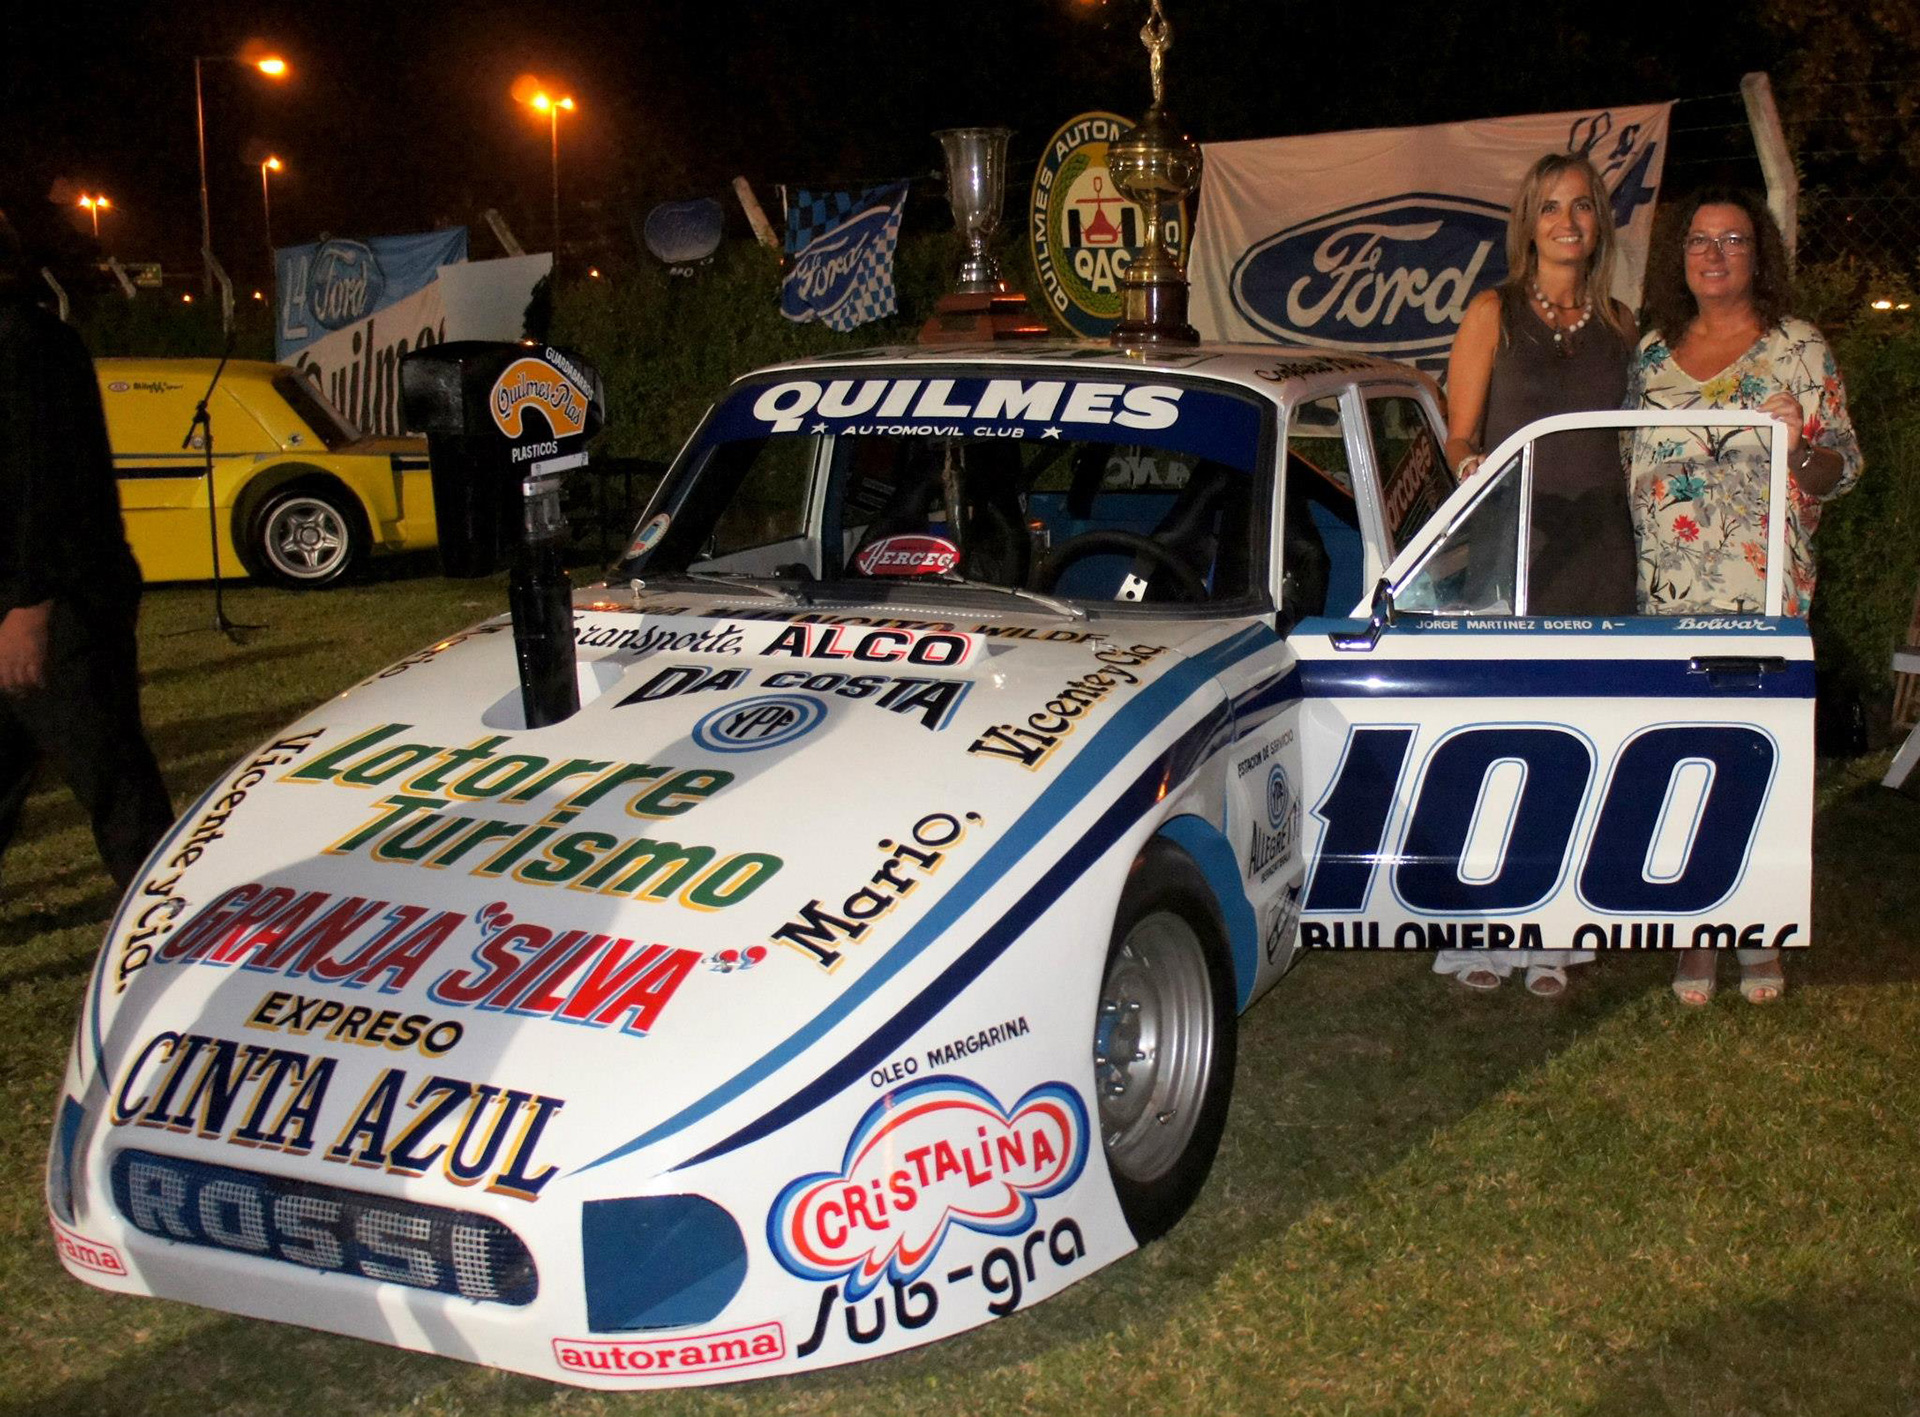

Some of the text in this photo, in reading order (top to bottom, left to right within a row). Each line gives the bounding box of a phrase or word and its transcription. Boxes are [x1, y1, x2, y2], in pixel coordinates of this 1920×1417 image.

[800, 231, 870, 300] Ford
[1033, 166, 1069, 312] QUILMES
[1287, 217, 1493, 328] Ford
[752, 379, 1185, 434] QUILMES
[841, 425, 1026, 439] AUTOMOVIL CLUB
[511, 441, 558, 462] PLASTICOS
[759, 621, 974, 669] ALCO
[1415, 619, 1459, 631] JORGE
[1466, 619, 1536, 631] MARTINEZ
[1543, 619, 1593, 631] BOERO
[613, 664, 977, 733] DA COSTA
[729, 704, 795, 739] YPF
[965, 671, 1117, 772] Vicente
[168, 727, 328, 868] Vicente
[275, 722, 736, 820] Latorre
[321, 794, 784, 912] Turismo
[1301, 722, 1779, 916] 100
[154, 882, 467, 993] GRANJA
[242, 992, 465, 1060] EXPRESO
[870, 1016, 1031, 1089] OLEO MARGARINA
[110, 1031, 566, 1203] CINTA AZUL
[128, 1160, 502, 1300] ROSSI
[560, 1332, 780, 1369] autorama
